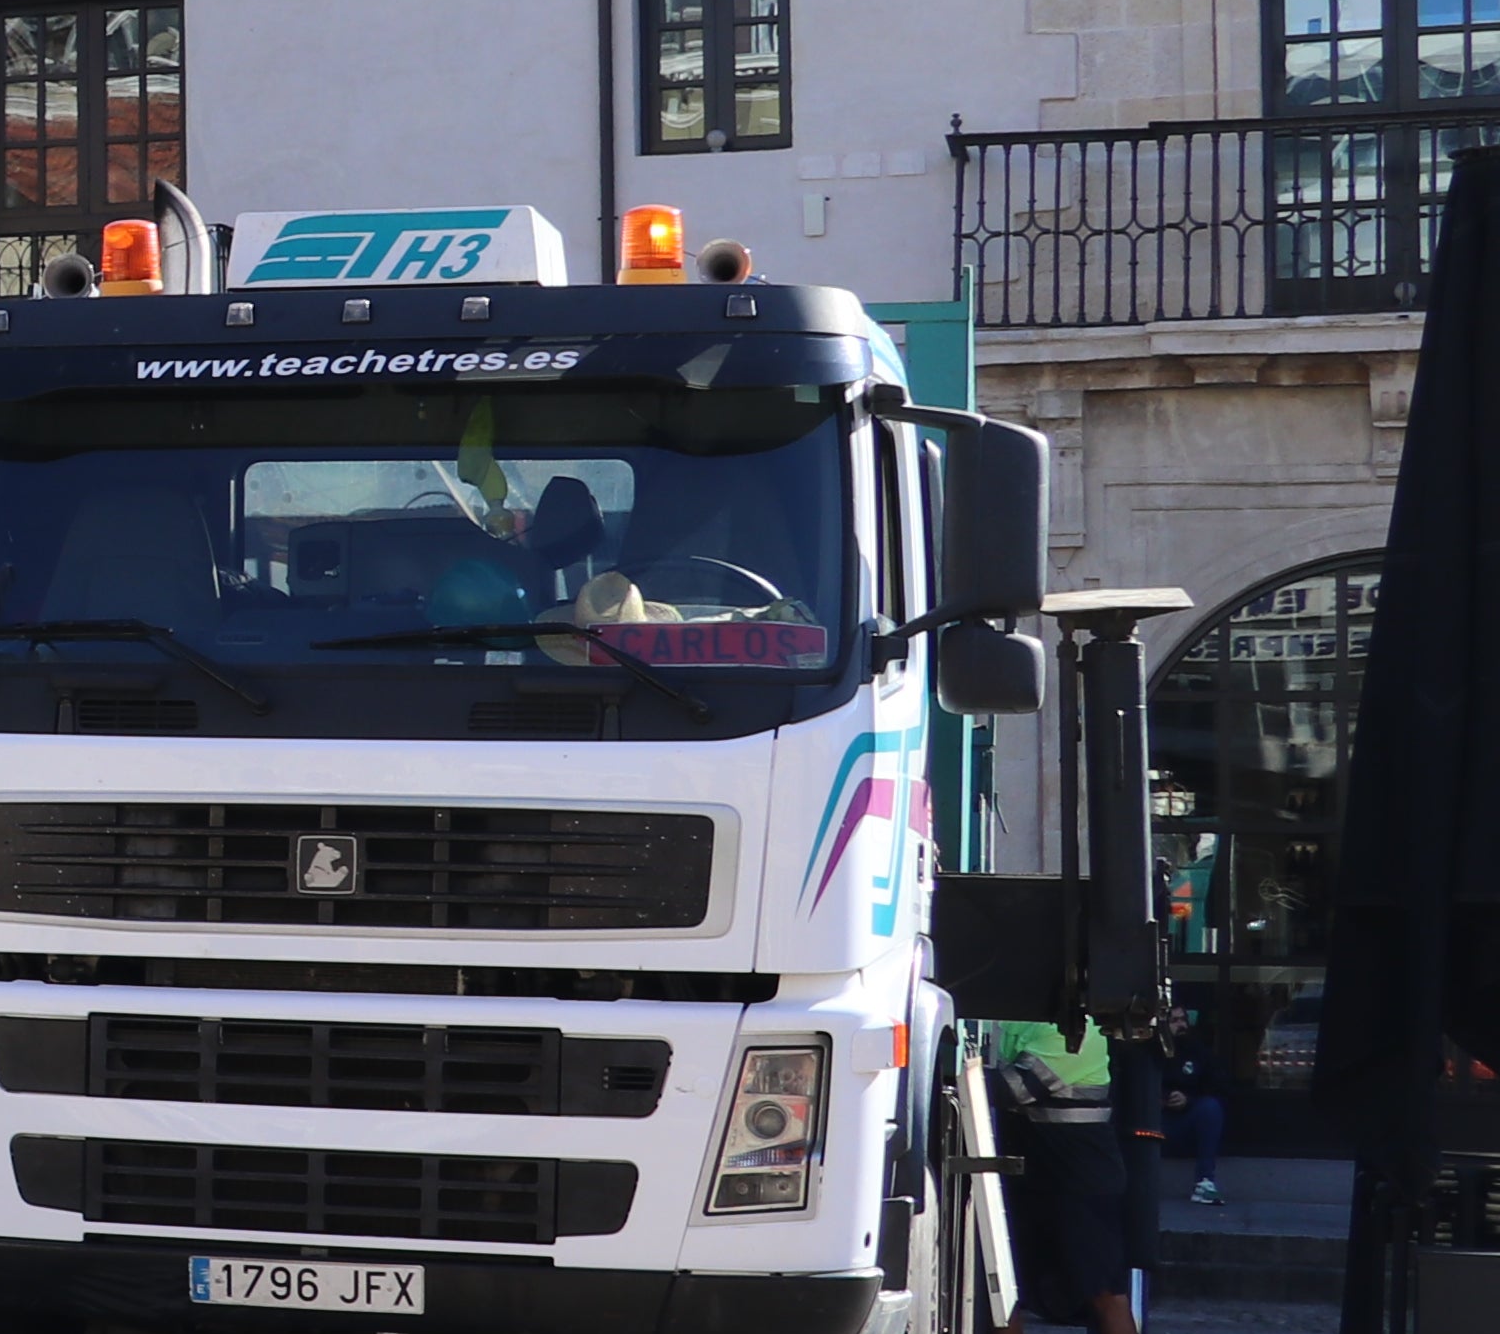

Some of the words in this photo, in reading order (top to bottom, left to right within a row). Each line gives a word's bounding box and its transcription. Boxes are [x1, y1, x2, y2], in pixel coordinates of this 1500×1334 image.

[135, 347, 581, 380] www.teachetres.es
[617, 626, 798, 664] CARLOS
[221, 1263, 320, 1303] 1796
[339, 1269, 415, 1308] JFX
